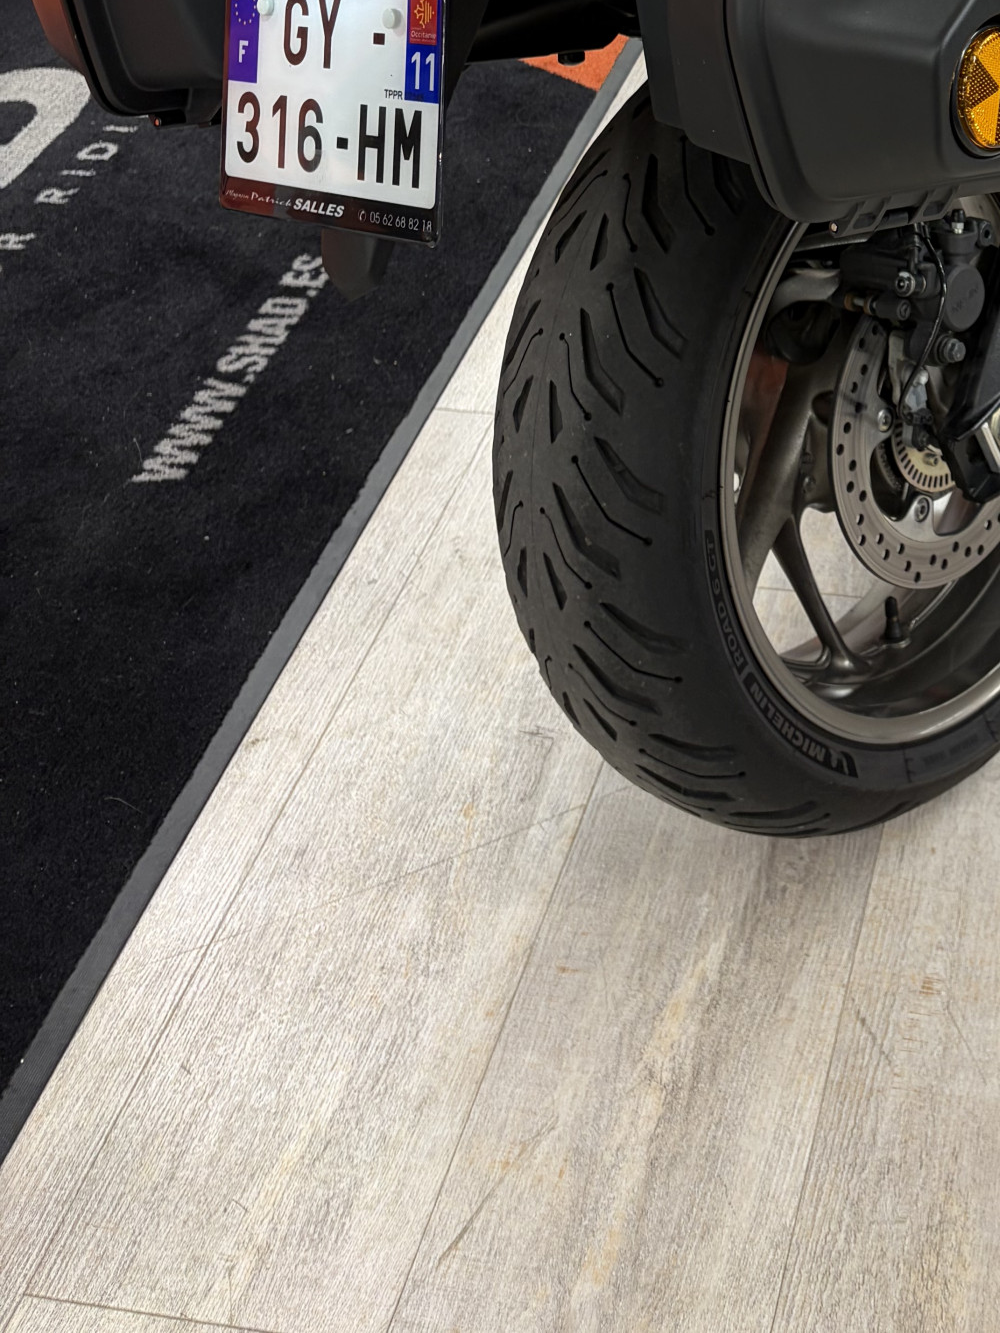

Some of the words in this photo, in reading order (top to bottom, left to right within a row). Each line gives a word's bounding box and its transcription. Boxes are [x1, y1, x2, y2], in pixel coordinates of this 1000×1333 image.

[238, 40, 249, 63] F
[411, 30, 436, 40] Occitanie
[411, 51, 435, 92] 11
[384, 89, 403, 100] TPPR
[236, 91, 423, 189] 316-HM
[250, 191, 292, 207] Patrick
[293, 198, 345, 218] SALLES
[370, 211, 380, 224] 05
[382, 213, 393, 226] 62
[395, 215, 406, 228] 68
[408, 217, 419, 230] 82
[422, 219, 432, 232] 18
[131, 254, 329, 483] WWW.SHAD.ES
[716, 598, 746, 669] ROAD
[749, 679, 828, 764] MICHELIN
